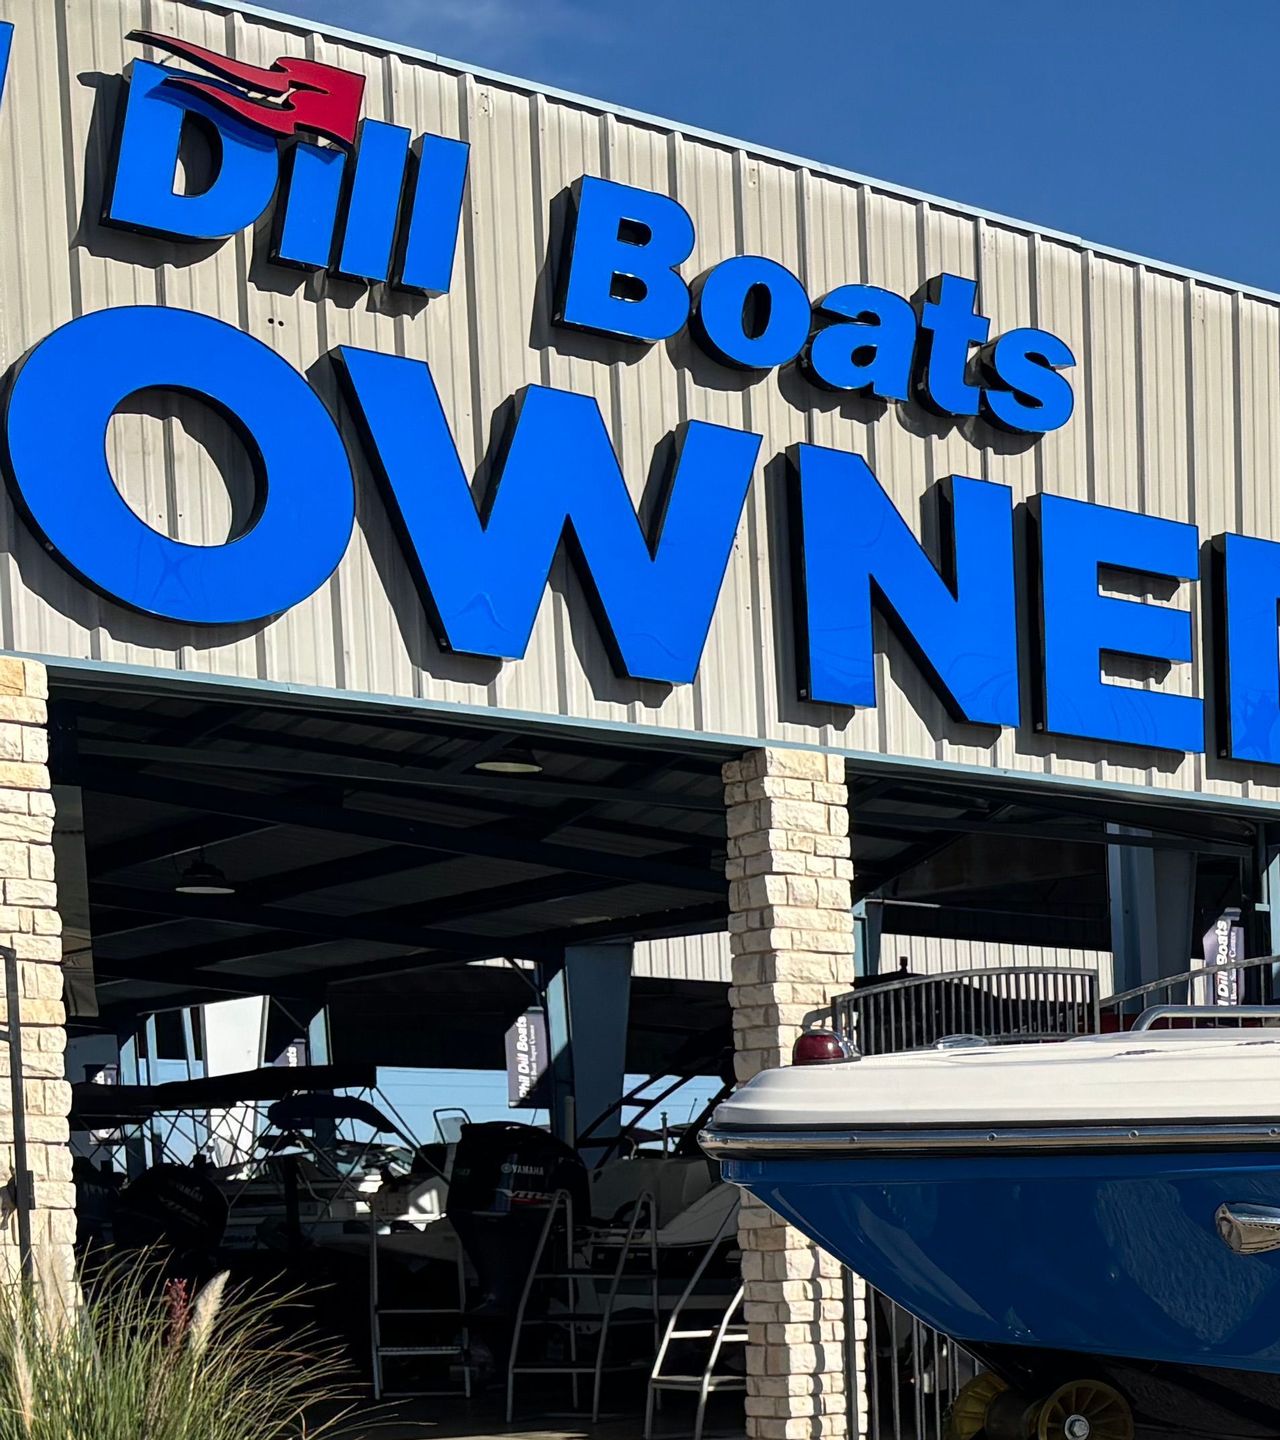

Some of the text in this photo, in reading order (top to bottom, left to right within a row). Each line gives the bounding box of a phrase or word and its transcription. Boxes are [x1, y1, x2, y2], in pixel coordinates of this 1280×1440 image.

[102, 58, 1076, 434] Dill Boats
[515, 1015, 529, 1051] Boats
[511, 1164, 544, 1176] YAMAHA
